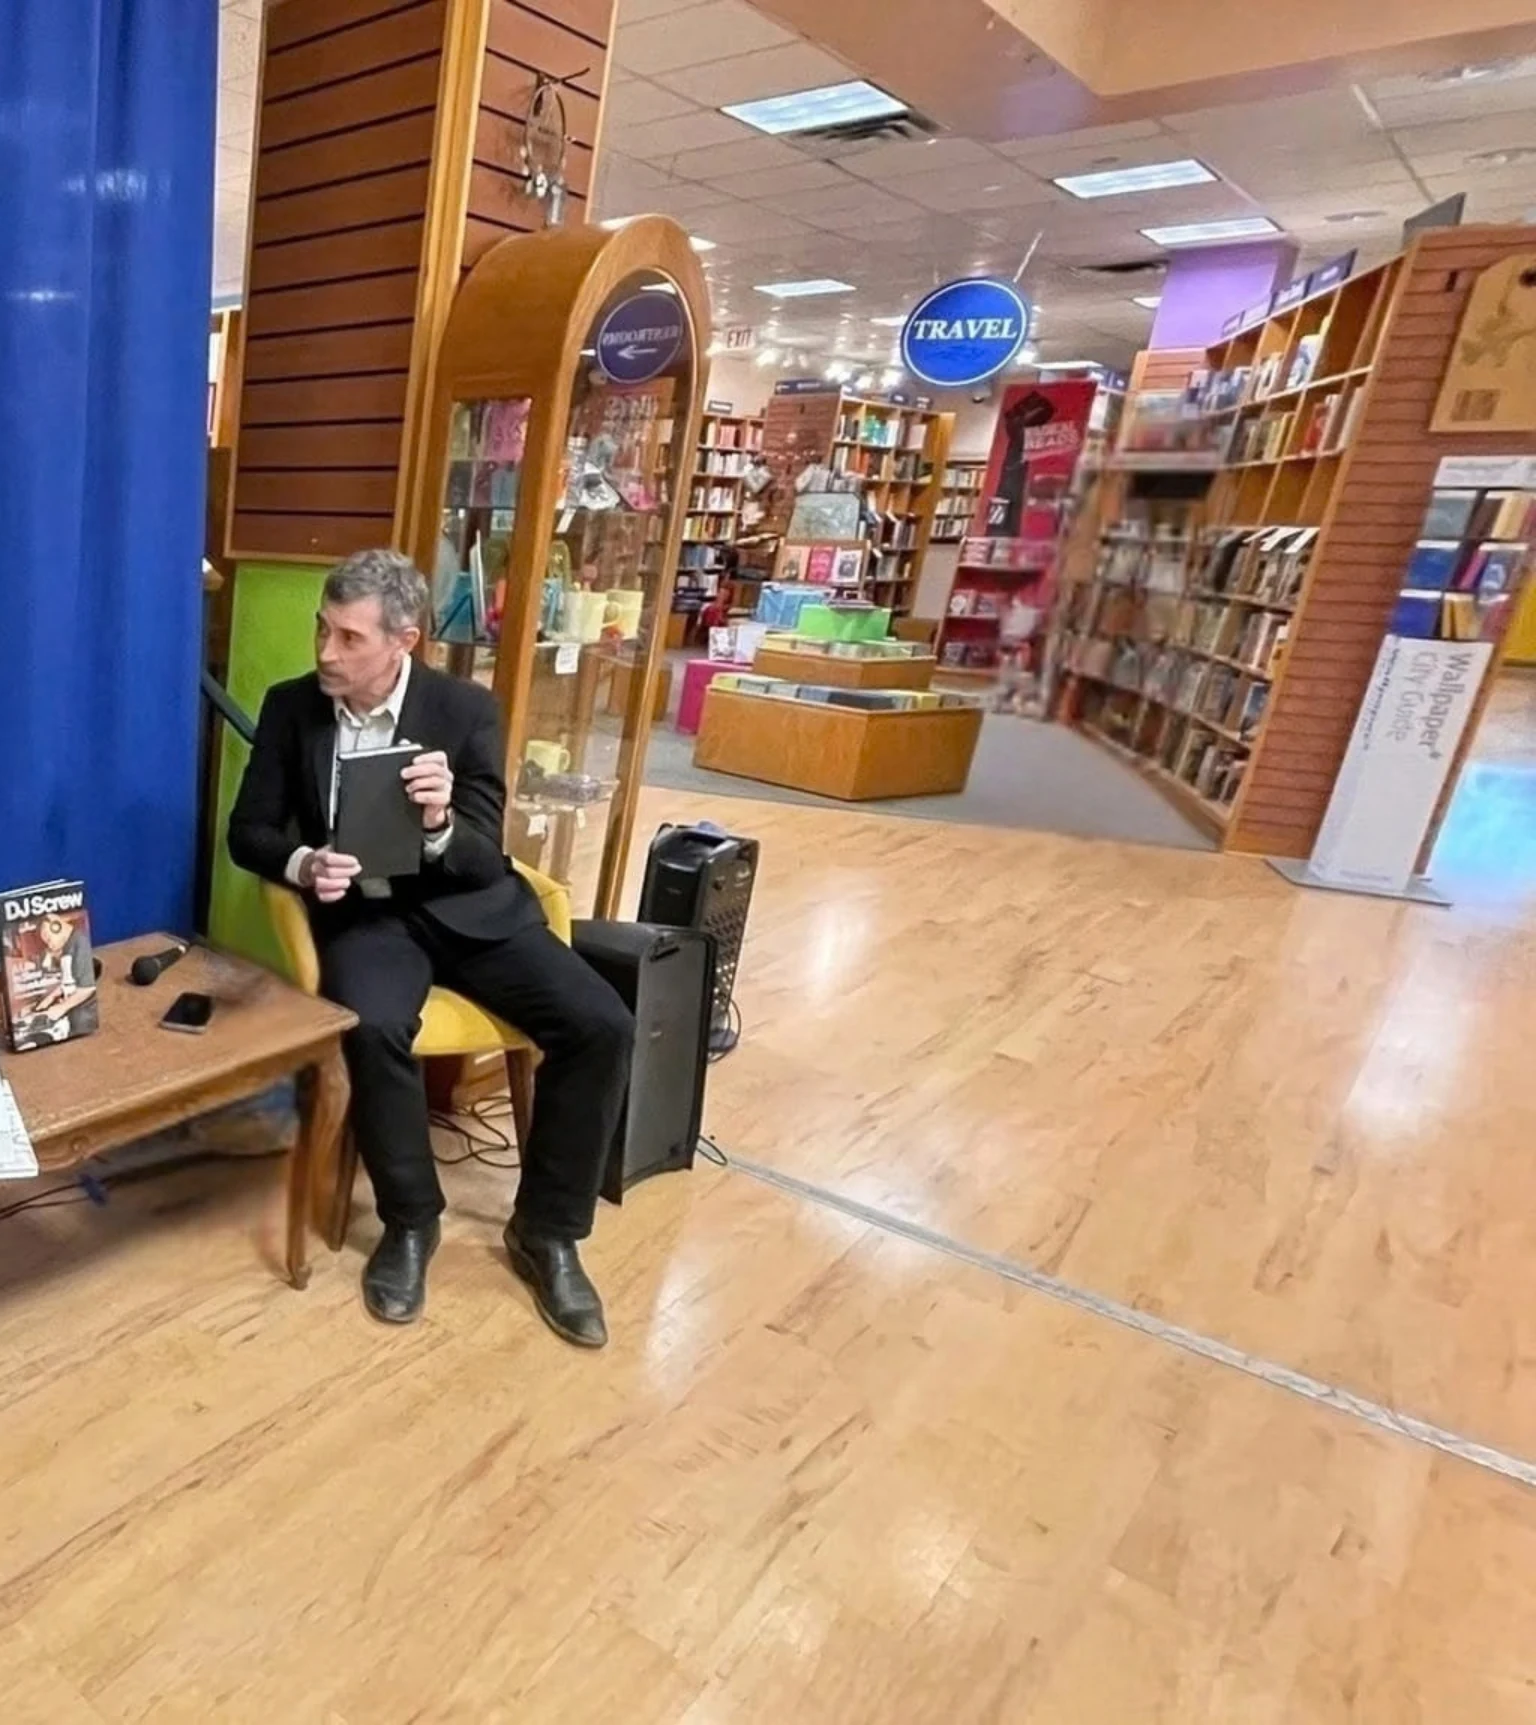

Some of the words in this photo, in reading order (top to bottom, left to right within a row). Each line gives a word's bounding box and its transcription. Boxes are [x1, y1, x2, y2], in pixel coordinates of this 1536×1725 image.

[914, 318, 1017, 340] TRAVEL
[4, 898, 29, 921] DJ
[31, 891, 83, 916] Screw
